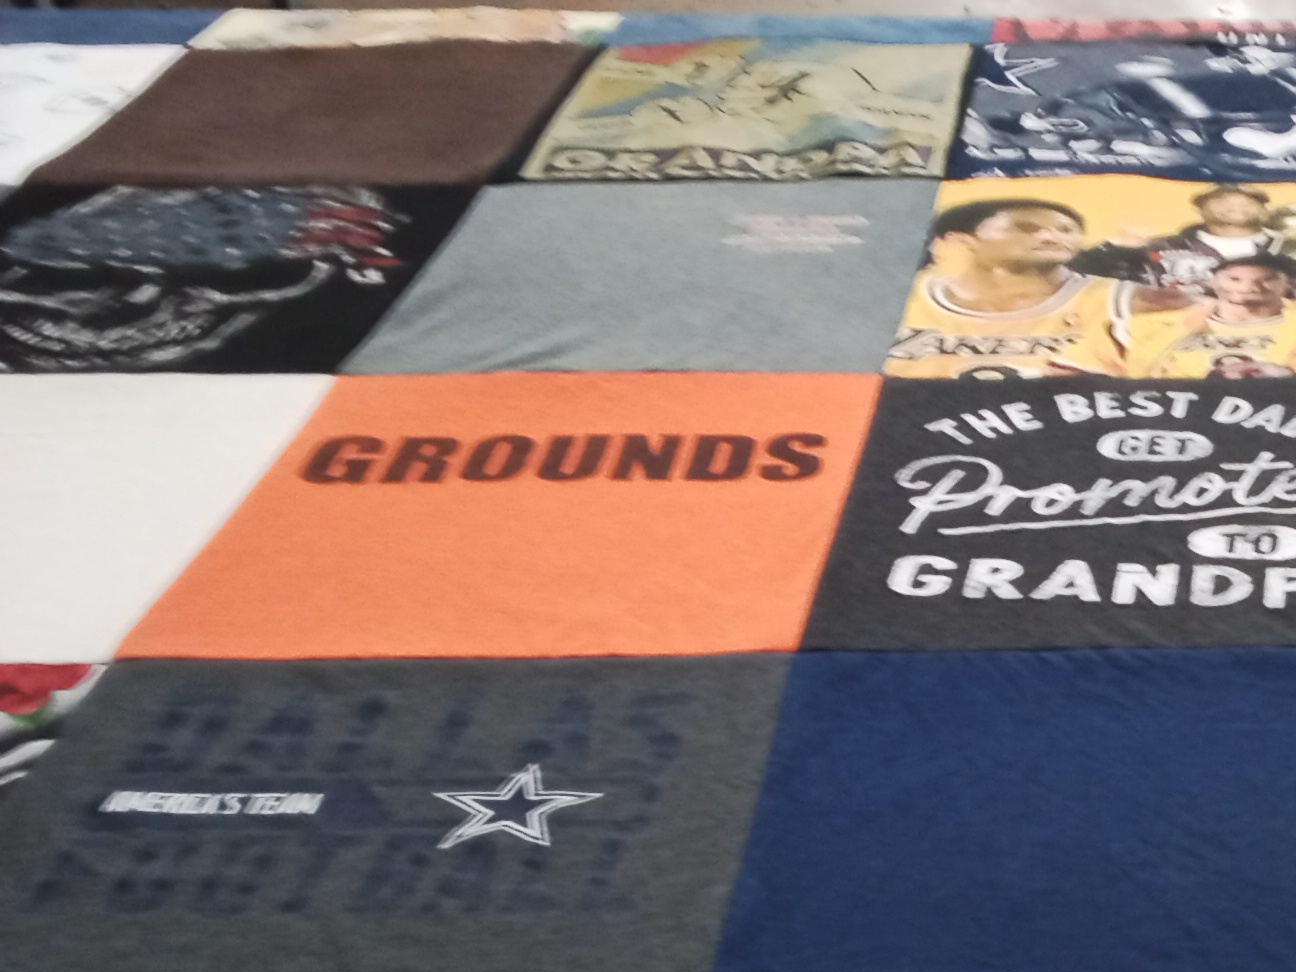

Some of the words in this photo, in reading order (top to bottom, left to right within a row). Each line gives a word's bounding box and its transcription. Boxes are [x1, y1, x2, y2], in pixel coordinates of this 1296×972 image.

[925, 403, 1043, 444] THE
[1053, 391, 1198, 422] BEST
[302, 434, 826, 483] GROUNDS
[1118, 435, 1196, 457] GET
[1223, 532, 1278, 553] TO
